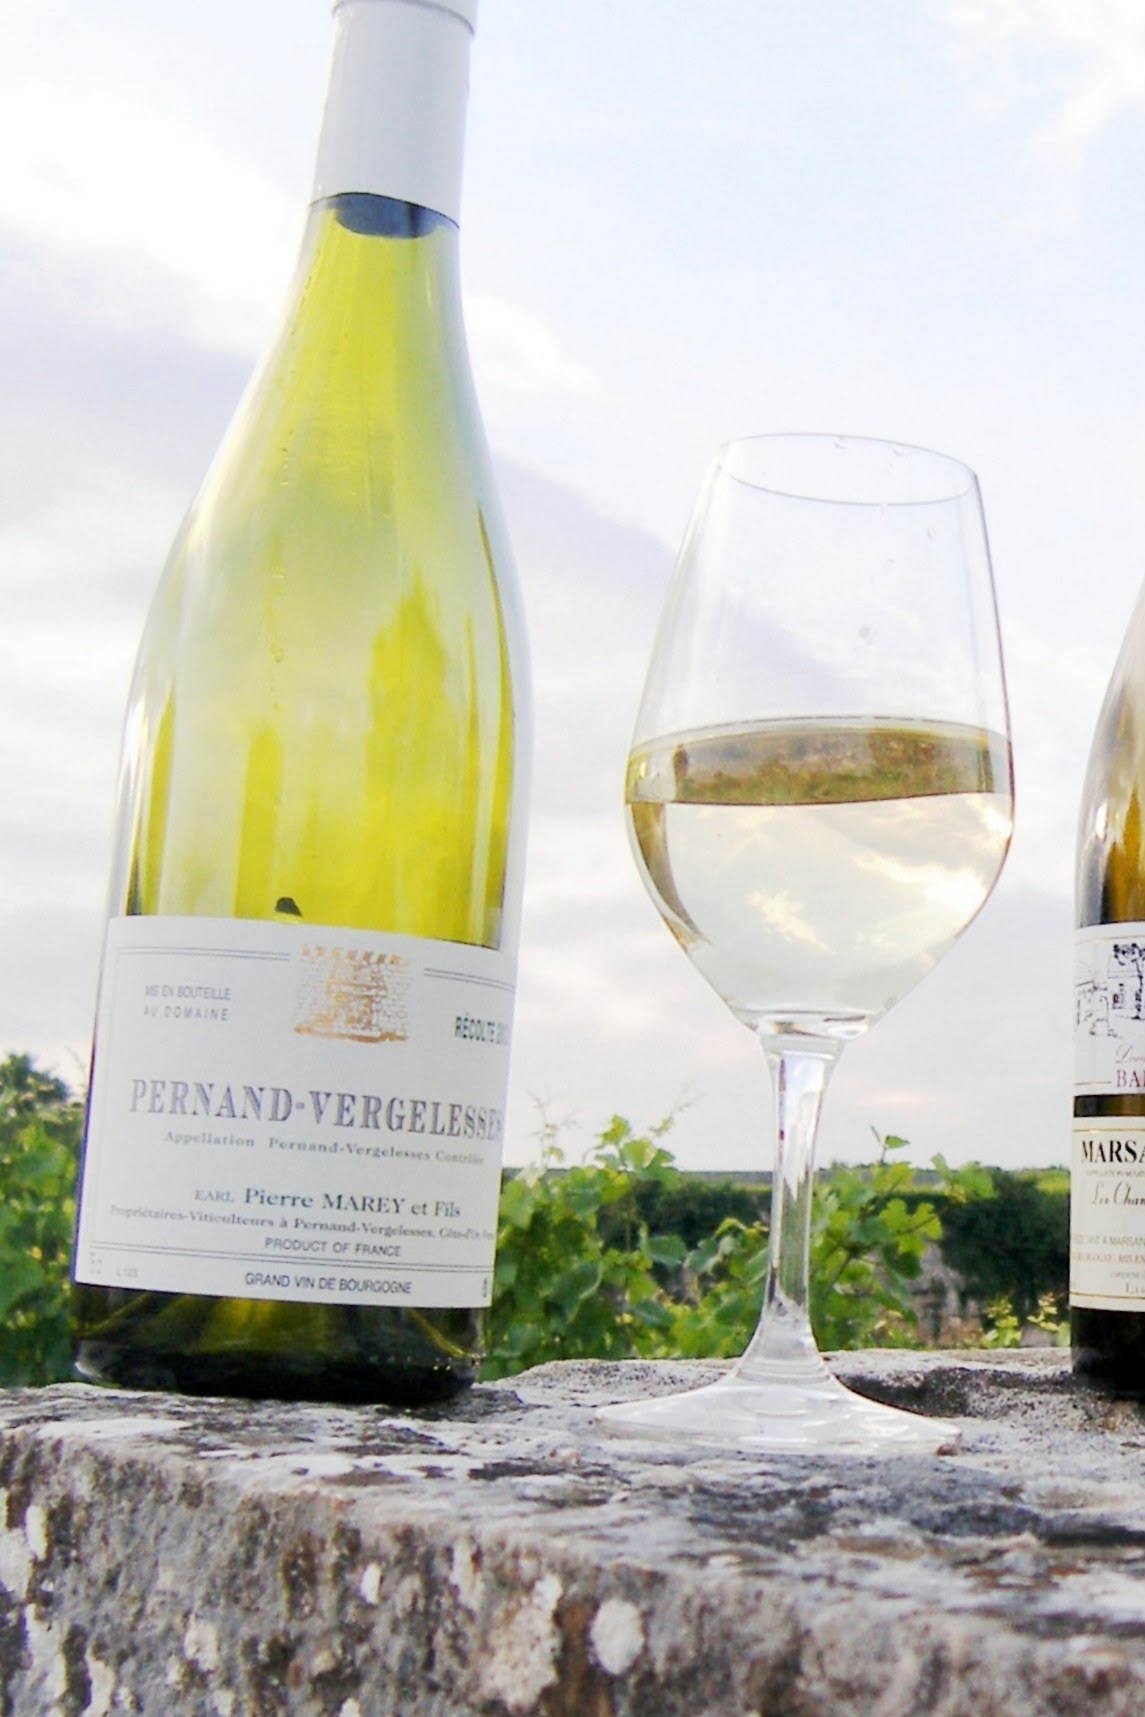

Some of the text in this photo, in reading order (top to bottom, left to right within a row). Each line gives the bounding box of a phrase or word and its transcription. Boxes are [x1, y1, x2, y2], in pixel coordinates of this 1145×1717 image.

[177, 985, 232, 1001] BOUTEILLE
[164, 1005, 230, 1021] DOMAINE
[163, 1130, 256, 1149] Appellation
[268, 1137, 431, 1161] Pernand-Vergelesses
[243, 1187, 314, 1208] Pierre
[321, 1193, 405, 1216] MAREY
[411, 1203, 428, 1216] et
[434, 1200, 461, 1218] Fils
[280, 1215, 288, 1229] à
[264, 1236, 402, 1258] PRODUCT OF FRANCE
[245, 1271, 412, 1295] GRAND VIN DE BOURGOGNE
